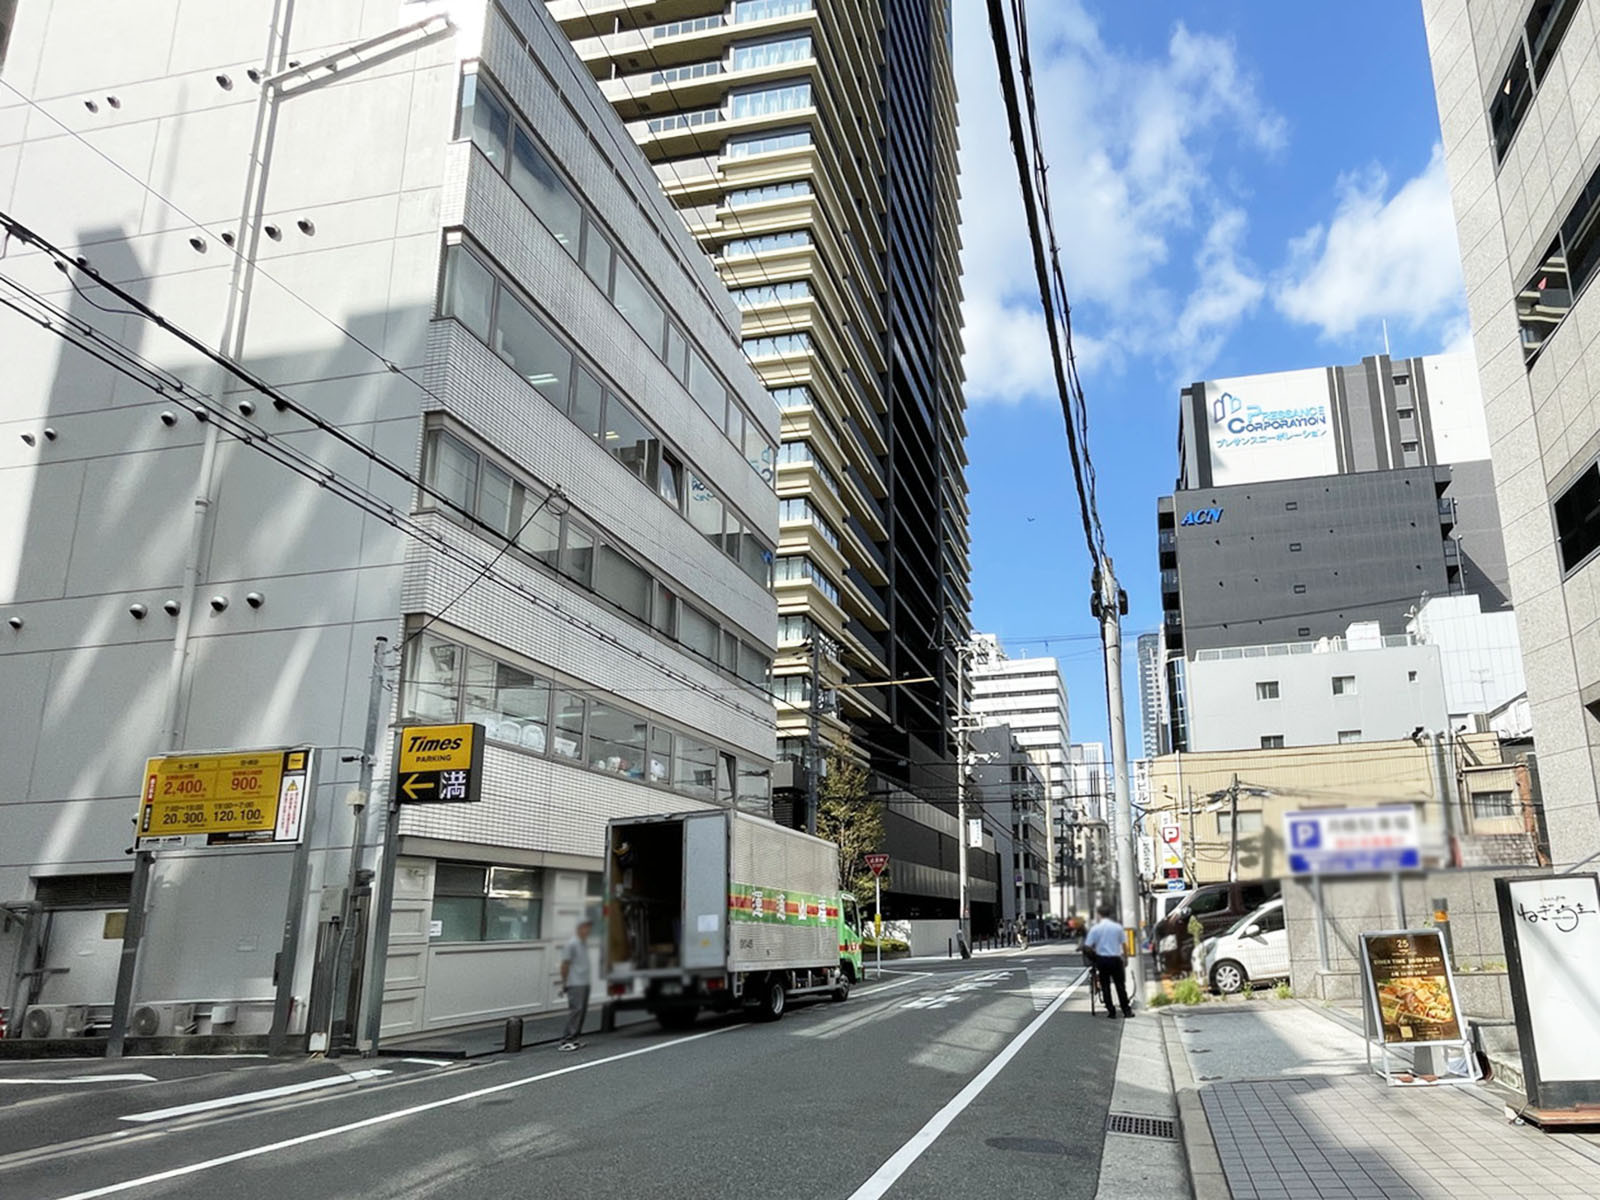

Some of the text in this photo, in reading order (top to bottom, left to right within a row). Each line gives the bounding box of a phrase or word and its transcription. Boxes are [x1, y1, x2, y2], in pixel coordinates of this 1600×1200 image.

[1227, 416, 1326, 434] CORPORATION
[1180, 508, 1224, 527] ACN
[408, 735, 464, 752] Times
[415, 754, 452, 762] PARKING
[440, 771, 466, 799] 満
